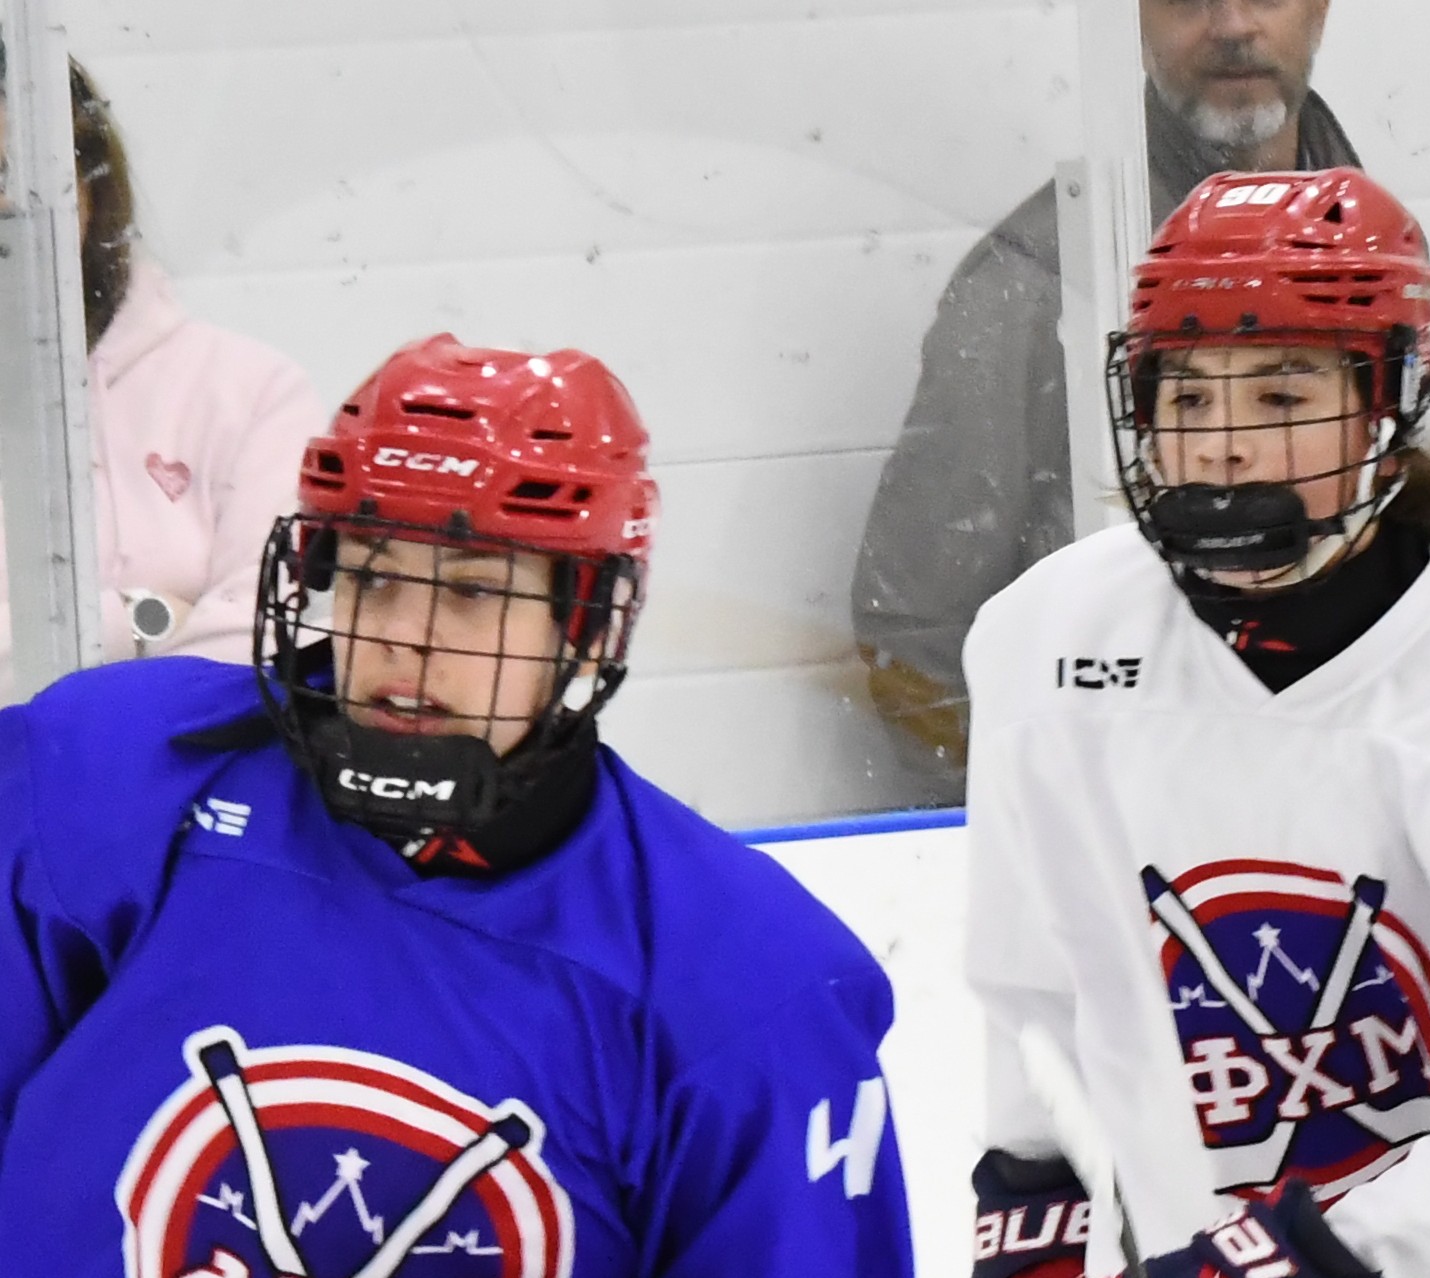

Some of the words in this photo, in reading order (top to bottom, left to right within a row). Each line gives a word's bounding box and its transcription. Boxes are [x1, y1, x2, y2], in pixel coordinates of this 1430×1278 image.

[1216, 183, 1291, 208] 90
[374, 447, 480, 476] CCM
[338, 768, 456, 801] CCM
[805, 1075, 888, 1201] 4
